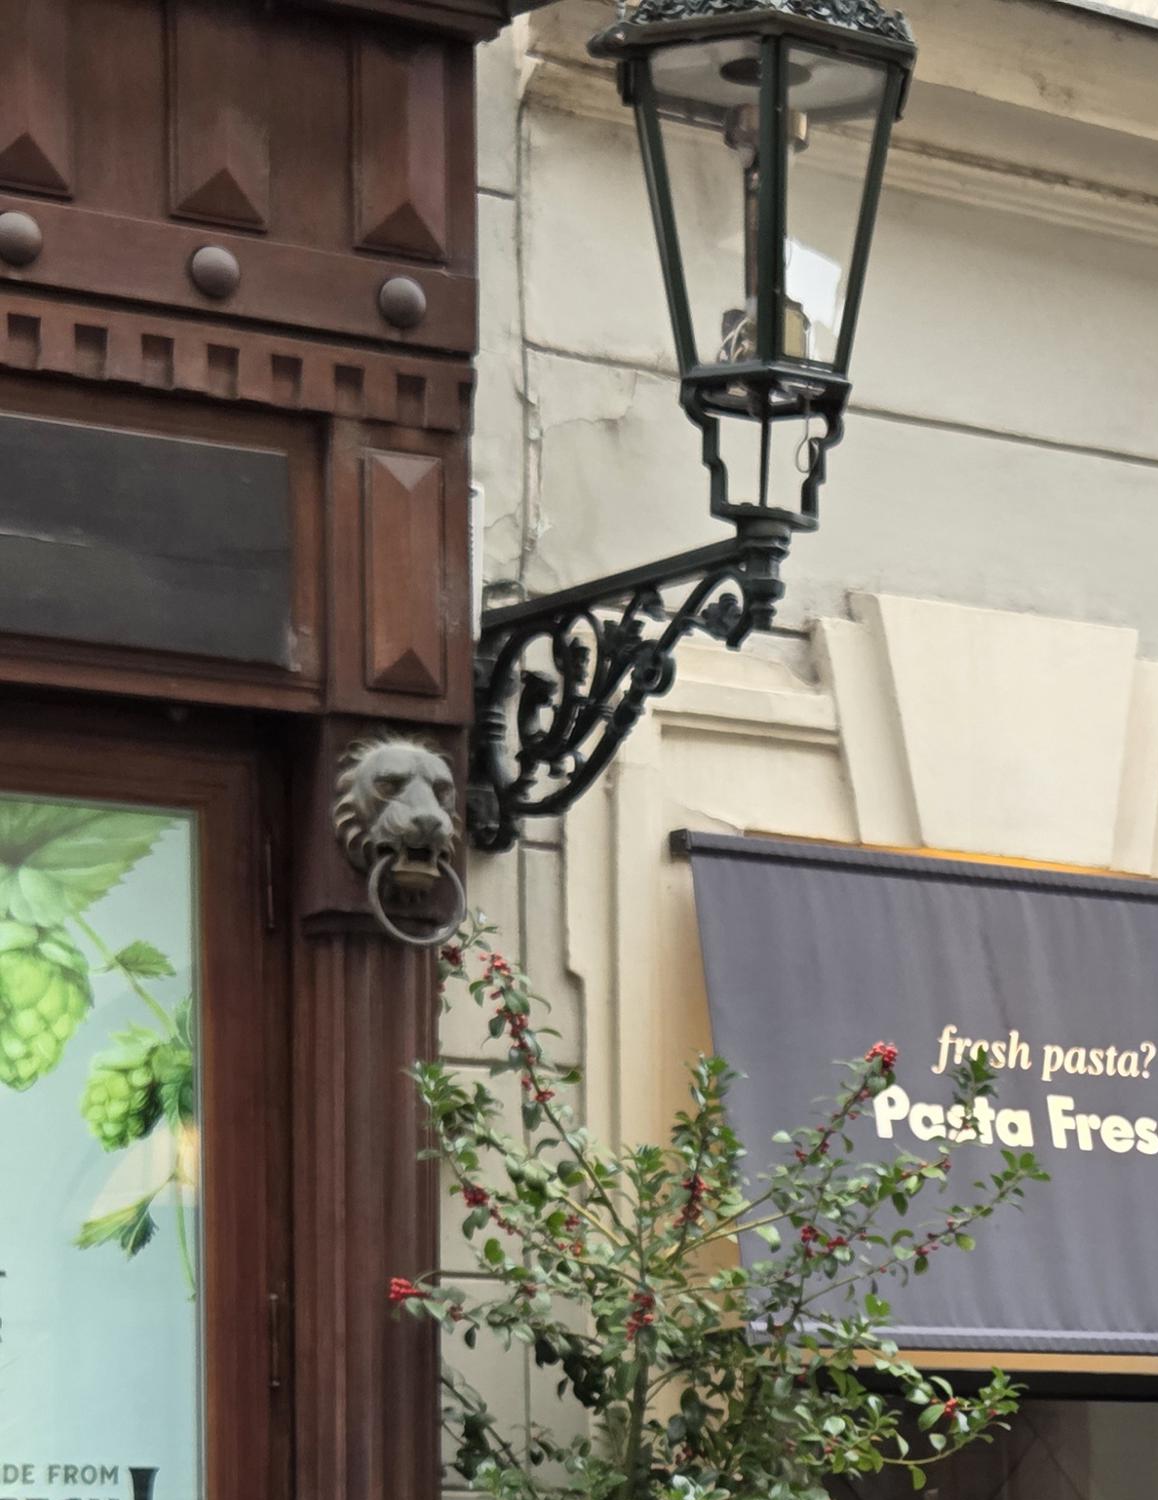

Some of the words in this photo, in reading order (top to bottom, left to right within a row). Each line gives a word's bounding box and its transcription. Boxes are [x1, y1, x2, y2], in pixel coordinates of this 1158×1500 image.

[1040, 1040, 1157, 1082] pasta?
[873, 1084, 1034, 1148] Pasta
[48, 1464, 119, 1485] FROM
